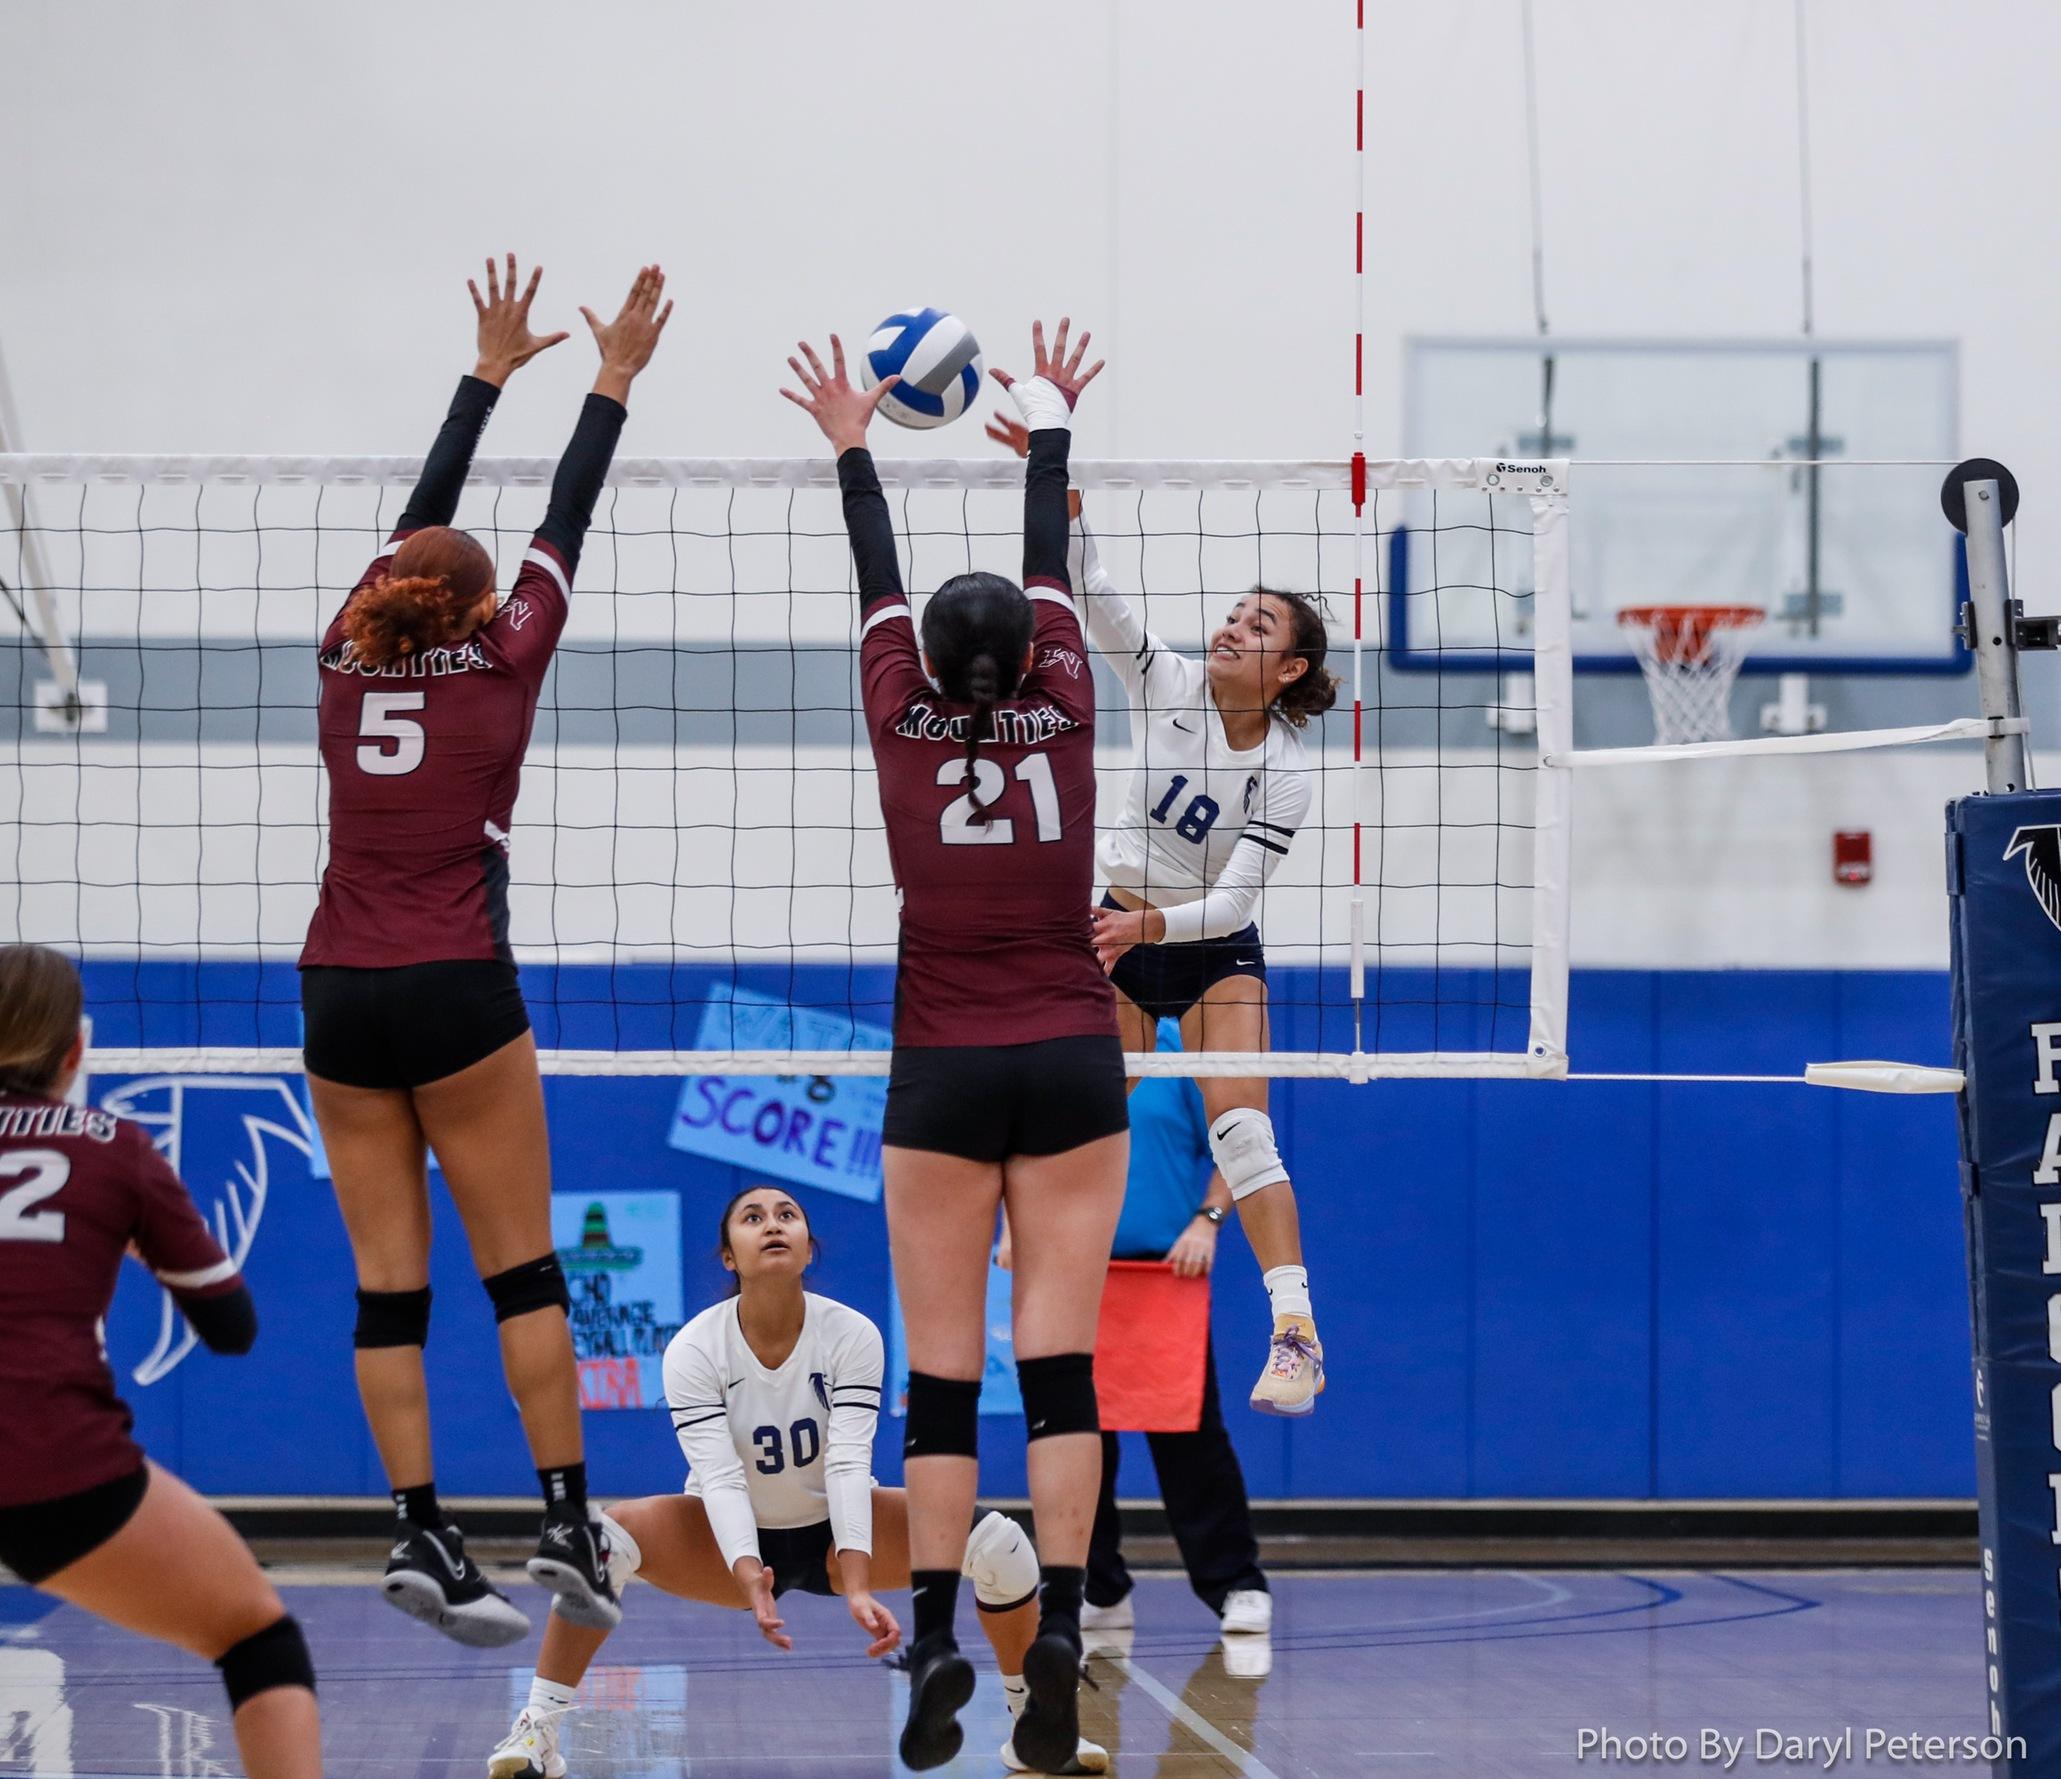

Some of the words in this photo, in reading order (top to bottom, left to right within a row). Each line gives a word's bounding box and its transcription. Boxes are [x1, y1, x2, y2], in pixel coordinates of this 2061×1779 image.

[1507, 464, 1546, 473] Senoh
[356, 691, 426, 776] 5
[936, 752, 1063, 845] 21
[1149, 774, 1221, 845] 18
[753, 1418, 820, 1475] 30
